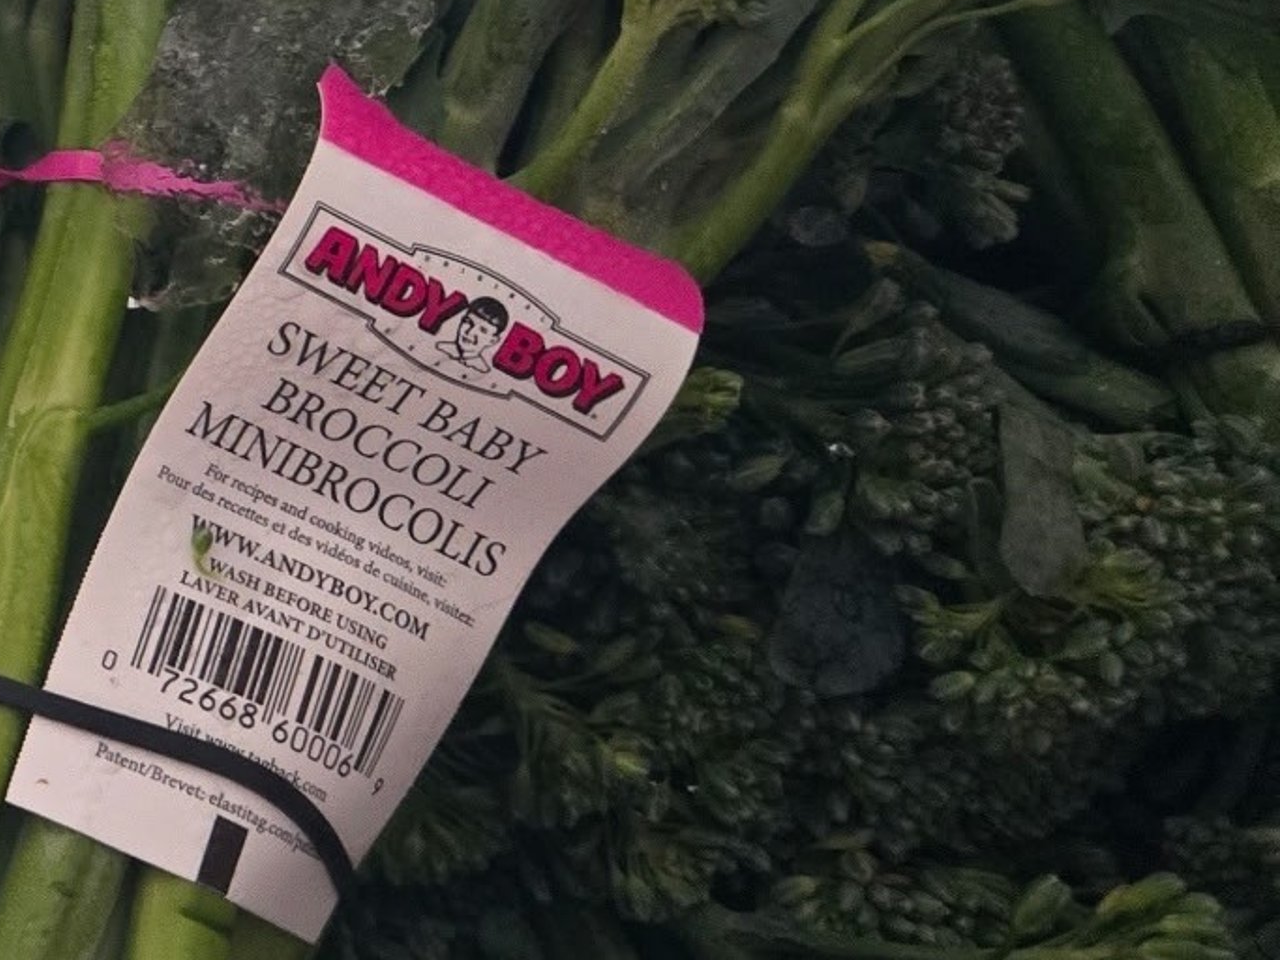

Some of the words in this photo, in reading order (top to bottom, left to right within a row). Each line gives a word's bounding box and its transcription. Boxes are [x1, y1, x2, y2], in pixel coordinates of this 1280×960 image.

[304, 226, 468, 336] ANDY
[491, 321, 624, 415] BOY
[259, 376, 496, 509] BROCCOLI
[266, 320, 427, 415] SWEET
[416, 397, 549, 475] BABY
[156, 463, 192, 491] Pour
[190, 480, 216, 503] des
[215, 495, 268, 526] recettes
[270, 521, 287, 535] et
[286, 525, 313, 547] des
[314, 538, 362, 569] vidéos
[361, 559, 381, 578] de
[381, 572, 431, 606] cuisine,
[183, 399, 507, 577] MINIBROCOLIS
[203, 461, 231, 484] For
[228, 477, 279, 507] recipes
[278, 500, 309, 521] and
[307, 514, 366, 552] cooking
[367, 540, 413, 574] videos,
[416, 564, 448, 589] visit:
[178, 568, 240, 607] LAVER
[240, 597, 306, 634] AVANT
[190, 512, 431, 642] WWW.ANDYBOY.COM
[208, 557, 261, 592] WASH
[261, 580, 333, 624] BEFORE
[335, 612, 388, 650] USING
[95, 740, 205, 800] Patent/Brevet:
[100, 648, 119, 671] 0
[159, 666, 259, 730] 72668
[271, 718, 360, 779] 60006
[370, 776, 385, 796] 9
